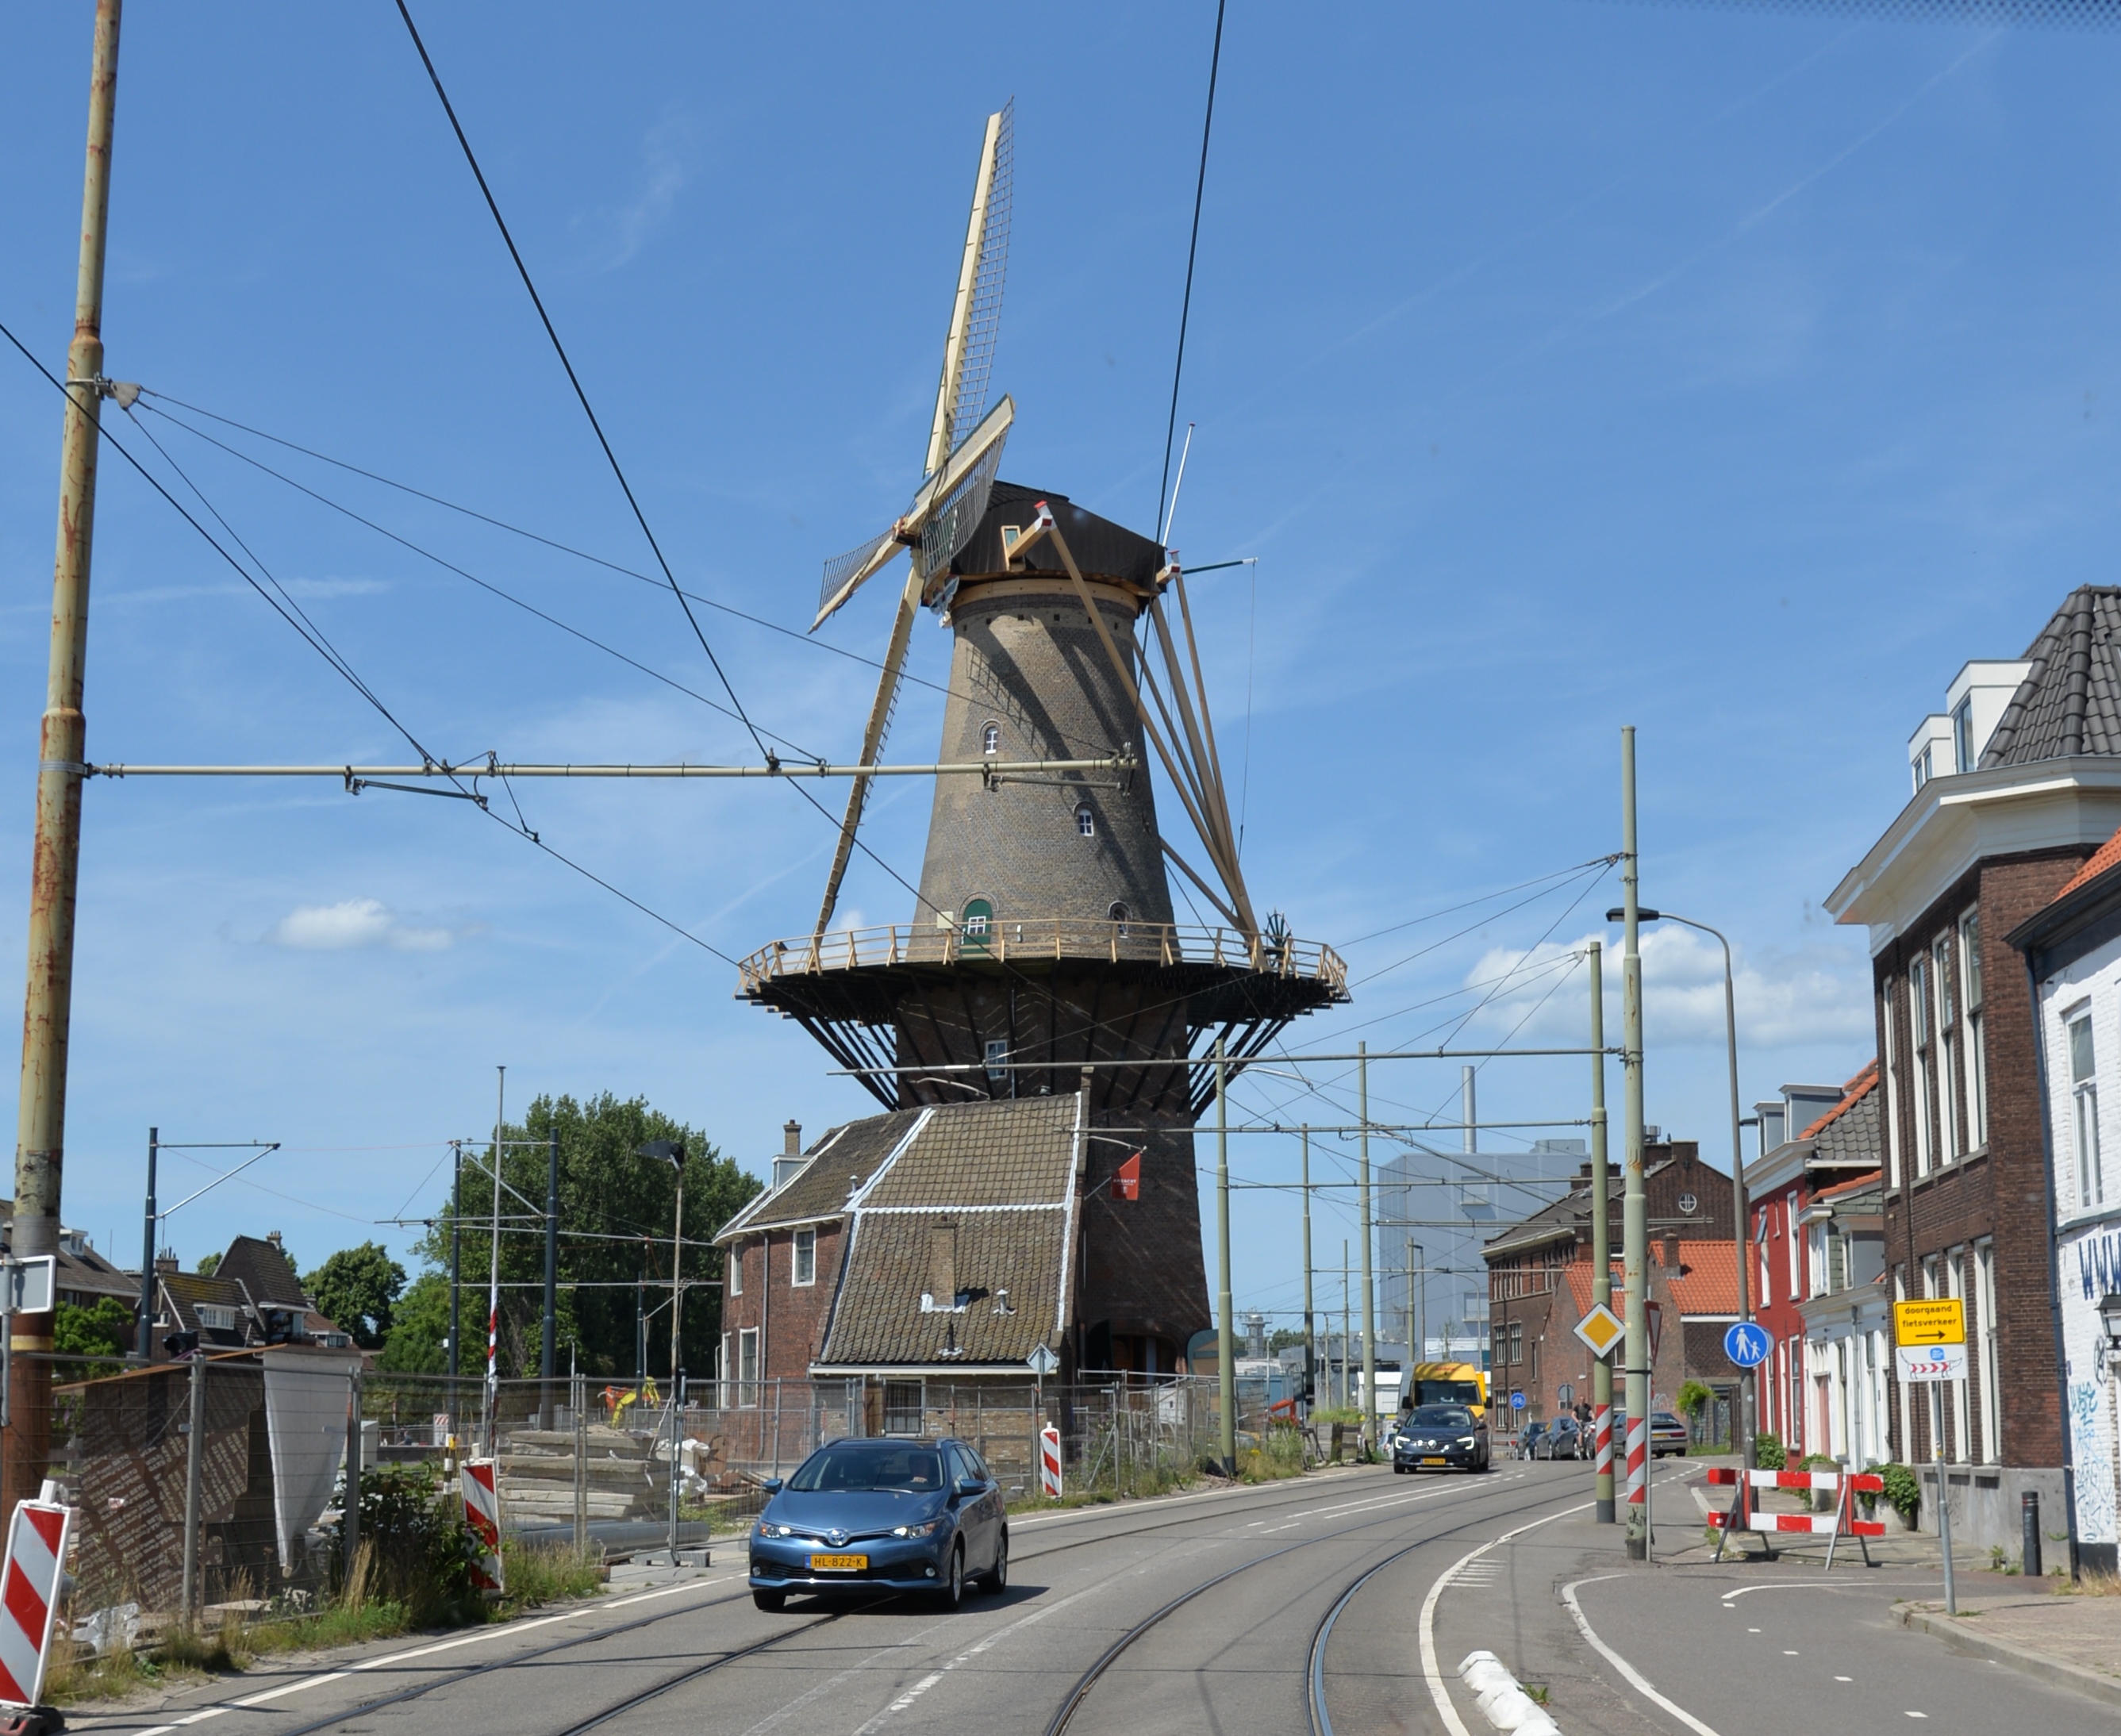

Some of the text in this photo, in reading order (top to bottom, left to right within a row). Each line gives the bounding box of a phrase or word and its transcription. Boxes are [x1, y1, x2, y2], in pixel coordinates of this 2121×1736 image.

[1905, 1305, 1952, 1315] doorgaand
[1902, 1319, 1957, 1327] fietsverkeer
[814, 1557, 863, 1567] HL-822-K
